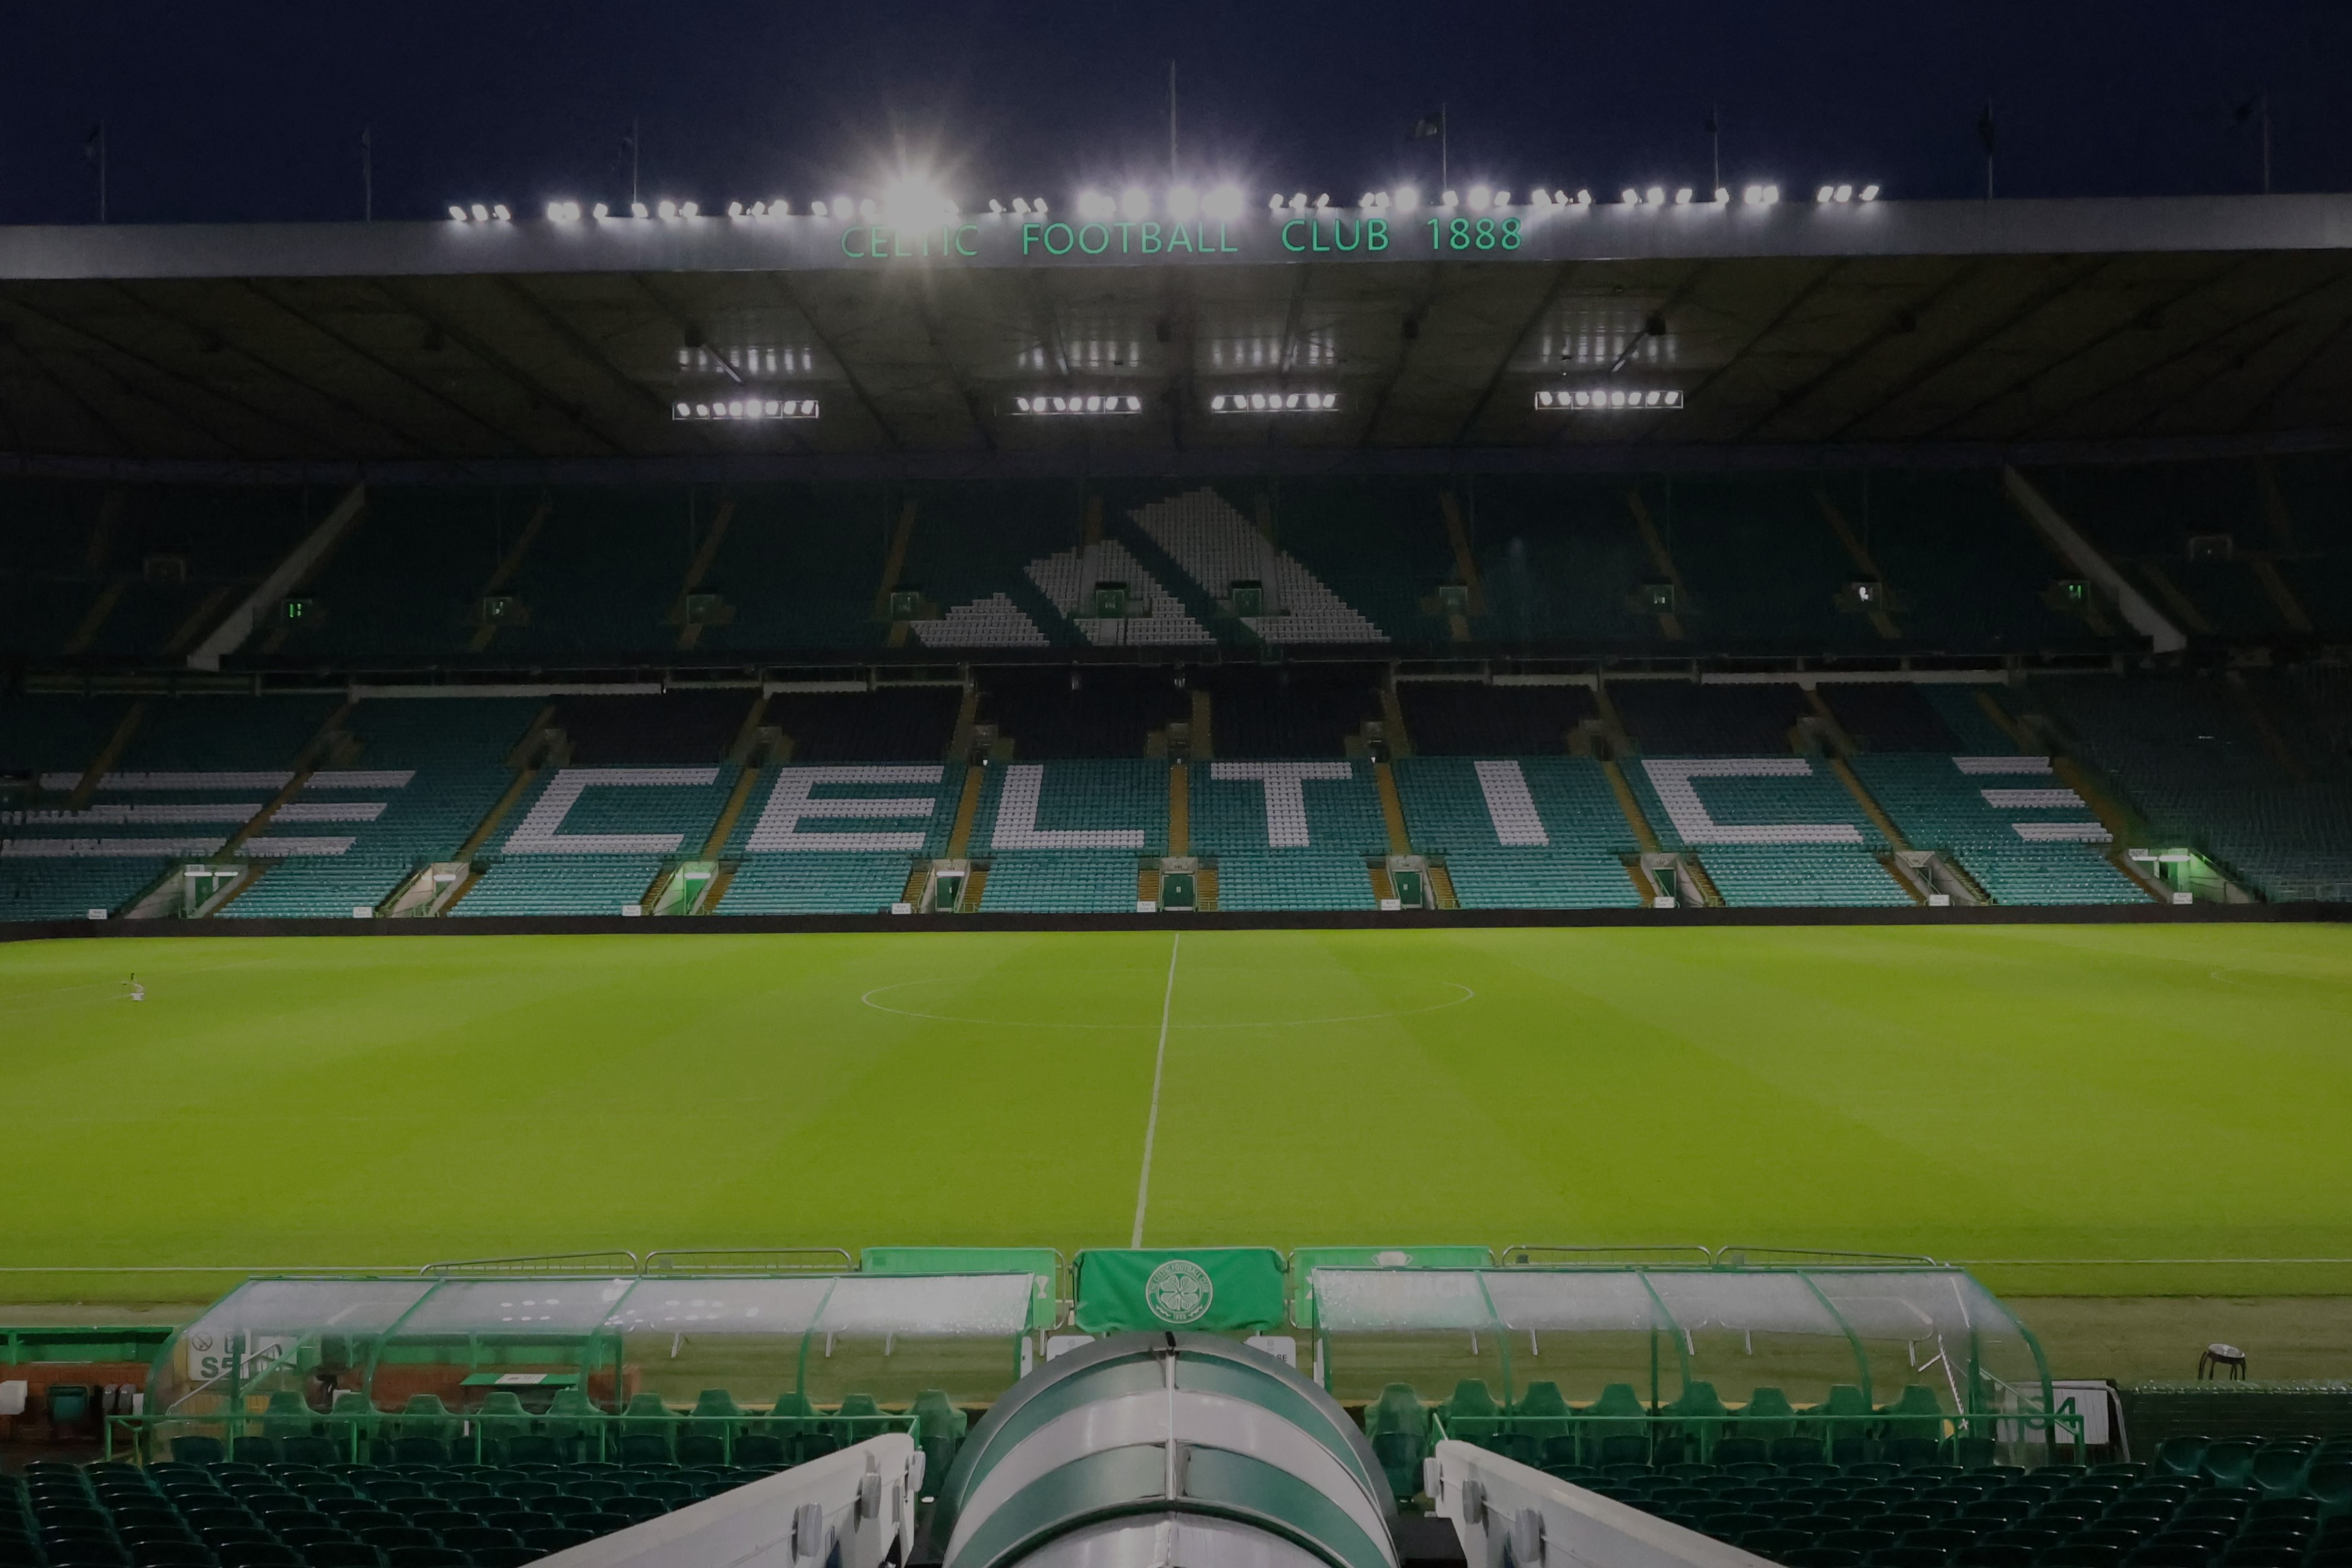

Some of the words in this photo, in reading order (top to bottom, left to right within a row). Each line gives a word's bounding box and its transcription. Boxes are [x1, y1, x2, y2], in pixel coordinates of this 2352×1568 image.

[1022, 221, 1238, 255] FOOTBALL
[1281, 219, 1390, 252] CLUB
[1427, 217, 1522, 250] 1888
[1170, 1262, 1204, 1279] FOOTBALL
